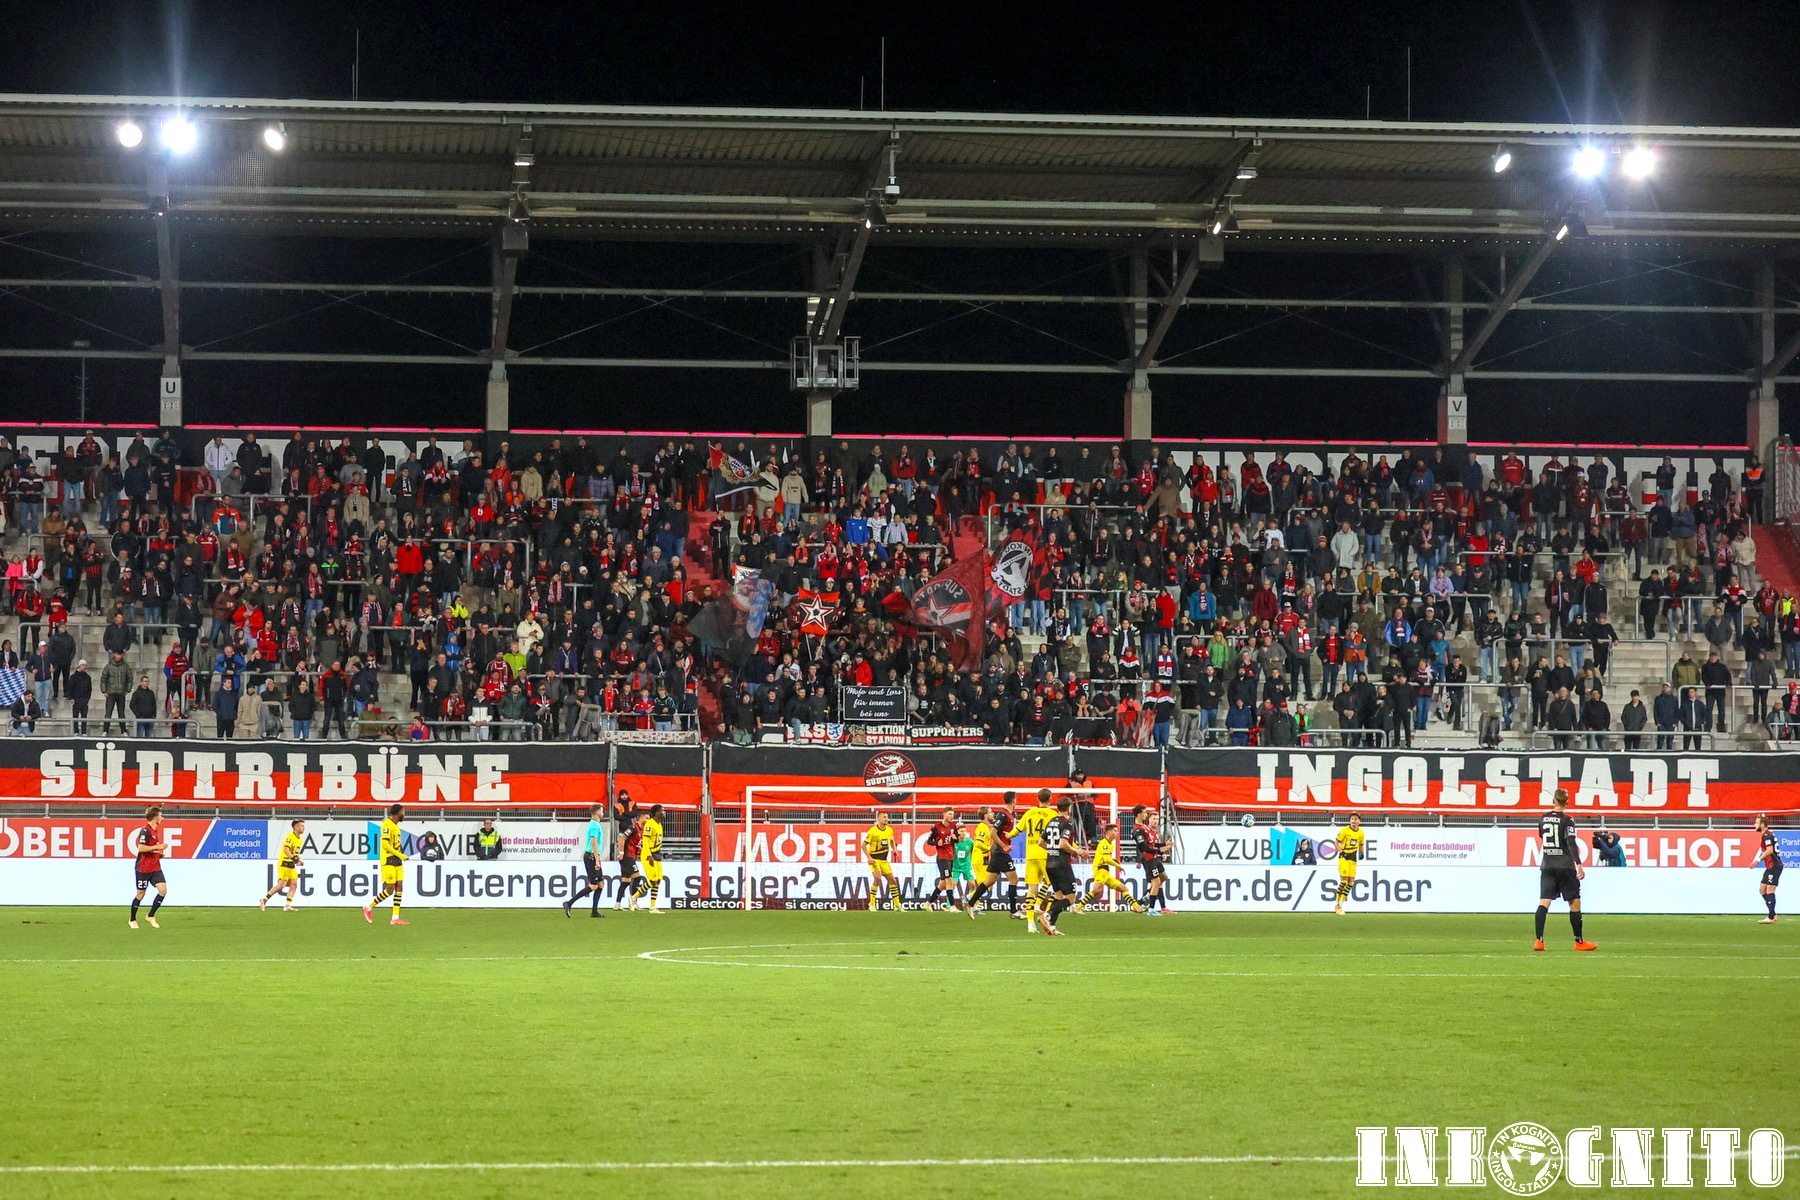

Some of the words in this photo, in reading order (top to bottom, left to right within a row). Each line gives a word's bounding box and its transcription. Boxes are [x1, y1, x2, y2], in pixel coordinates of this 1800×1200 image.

[166, 381, 175, 393] U
[1452, 400, 1462, 412] V
[886, 687, 903, 696] Lars
[866, 725, 906, 735] SEKTION
[911, 726, 984, 738] SUPPORTERS
[40, 742, 511, 802] SÜDTRIBÜNE
[1256, 753, 1720, 808] INGOLSTADT
[226, 828, 261, 838] Parsberg
[1028, 818, 1045, 837] 14
[513, 837, 534, 845] deine
[535, 837, 580, 846] Ausbildung!
[1046, 827, 1060, 849] 32
[1542, 823, 1560, 848] 21
[223, 839, 261, 849] Ingolstadt
[300, 832, 378, 855] AZUBI
[1204, 838, 1280, 861] AZUBI
[1390, 842, 1410, 851] Finde
[1411, 842, 1432, 851] deine
[1432, 842, 1476, 852] Ausbildung!
[208, 851, 261, 859] moebelhof.de
[1399, 852, 1468, 860] www.azubimovie.de
[944, 869, 950, 877] 8
[138, 881, 148, 889] 23
[685, 866, 820, 899] sicher?
[675, 898, 687, 909] si
[785, 900, 797, 910] si
[800, 901, 847, 912] energy
